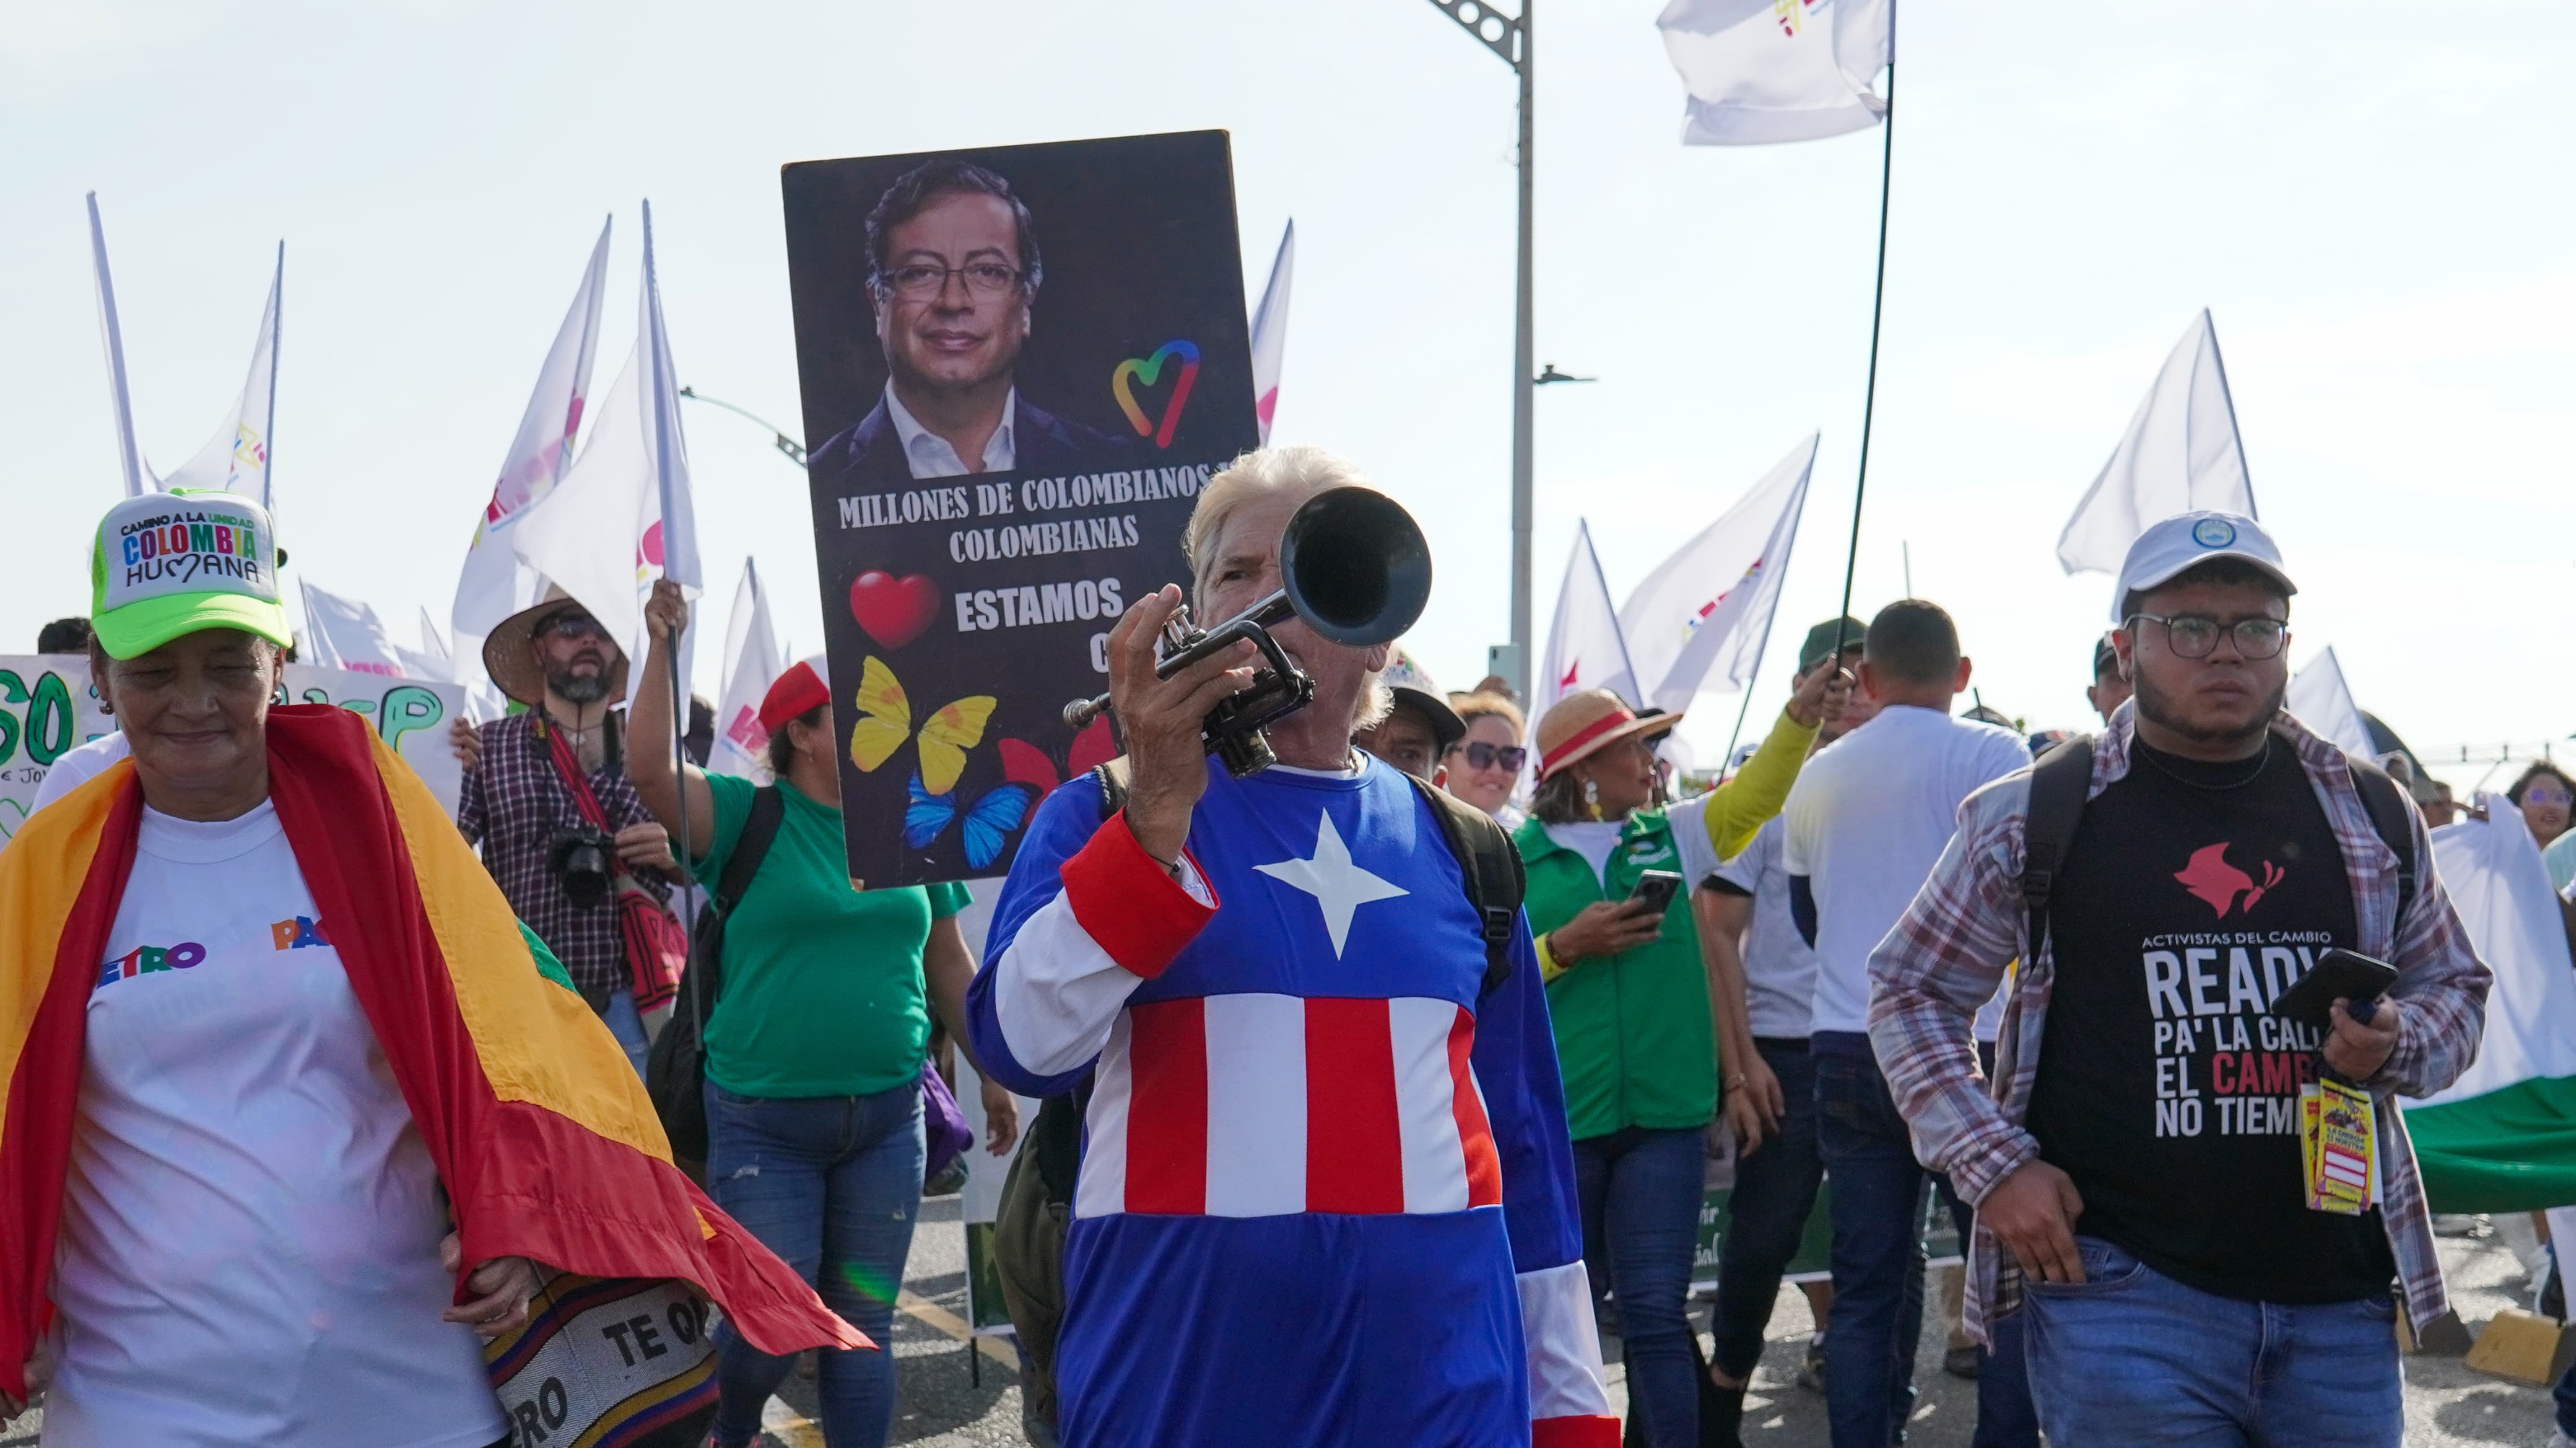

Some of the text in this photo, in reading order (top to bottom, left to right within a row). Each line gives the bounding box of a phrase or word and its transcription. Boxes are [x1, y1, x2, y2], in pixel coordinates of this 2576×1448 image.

[838, 464, 1211, 529] MILLONES DE COLOMBIANOS
[121, 512, 254, 536] CAMINO A LA UNIDAD
[123, 524, 257, 566] COLOMBIA
[949, 514, 1139, 563] COLOMBIANAS
[955, 577, 1124, 632] ESTAMOS
[2142, 930, 2332, 948] ACTIVISTAS DEL CAMBIO
[2212, 1016, 2252, 1052] LA
[2156, 1056, 2200, 1099] EL
[2155, 1096, 2301, 1138] NO TIEM
[601, 1313, 668, 1368] TE
